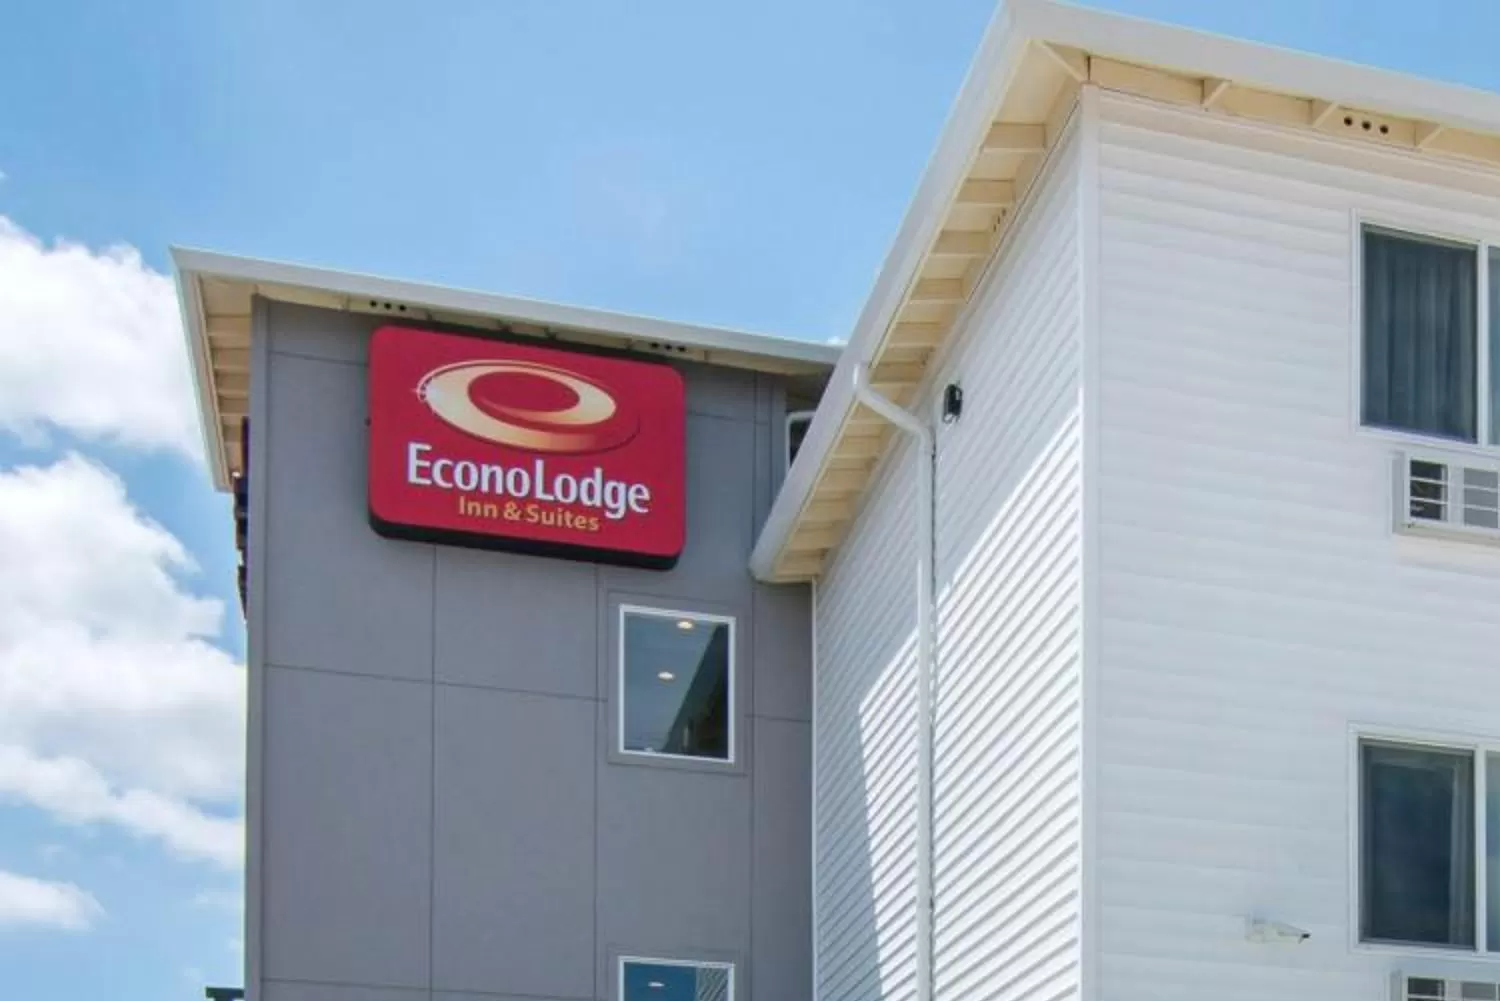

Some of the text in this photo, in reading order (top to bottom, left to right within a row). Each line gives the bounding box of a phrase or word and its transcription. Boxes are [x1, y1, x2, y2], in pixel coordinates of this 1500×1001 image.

[458, 496, 600, 531] Inn & Suites
